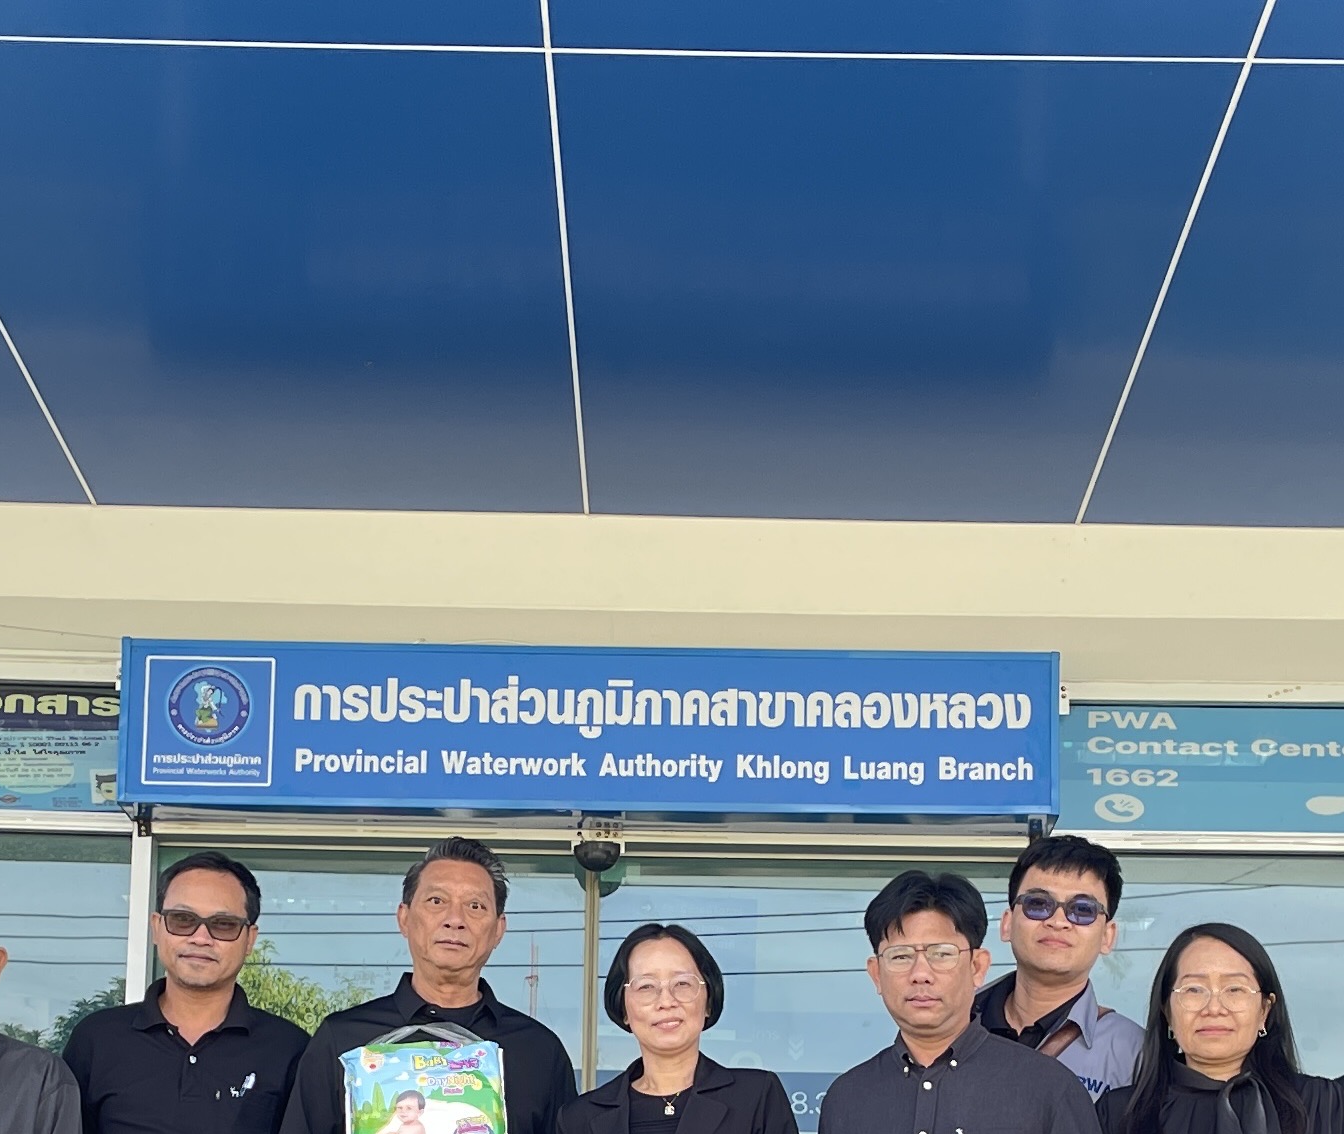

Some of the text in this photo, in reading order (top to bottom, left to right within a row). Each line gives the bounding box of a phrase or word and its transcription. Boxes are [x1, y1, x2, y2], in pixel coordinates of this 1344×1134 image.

[293, 675, 1033, 739] การประปาส่วนภูมิภาคสาขาคลองหลวง
[1087, 711, 1177, 731] PWA
[1087, 736, 1238, 756] Contact
[295, 748, 1035, 786] Provincial Waterwork Authority Khlong Luang Branch
[1087, 768, 1178, 787] 1662
